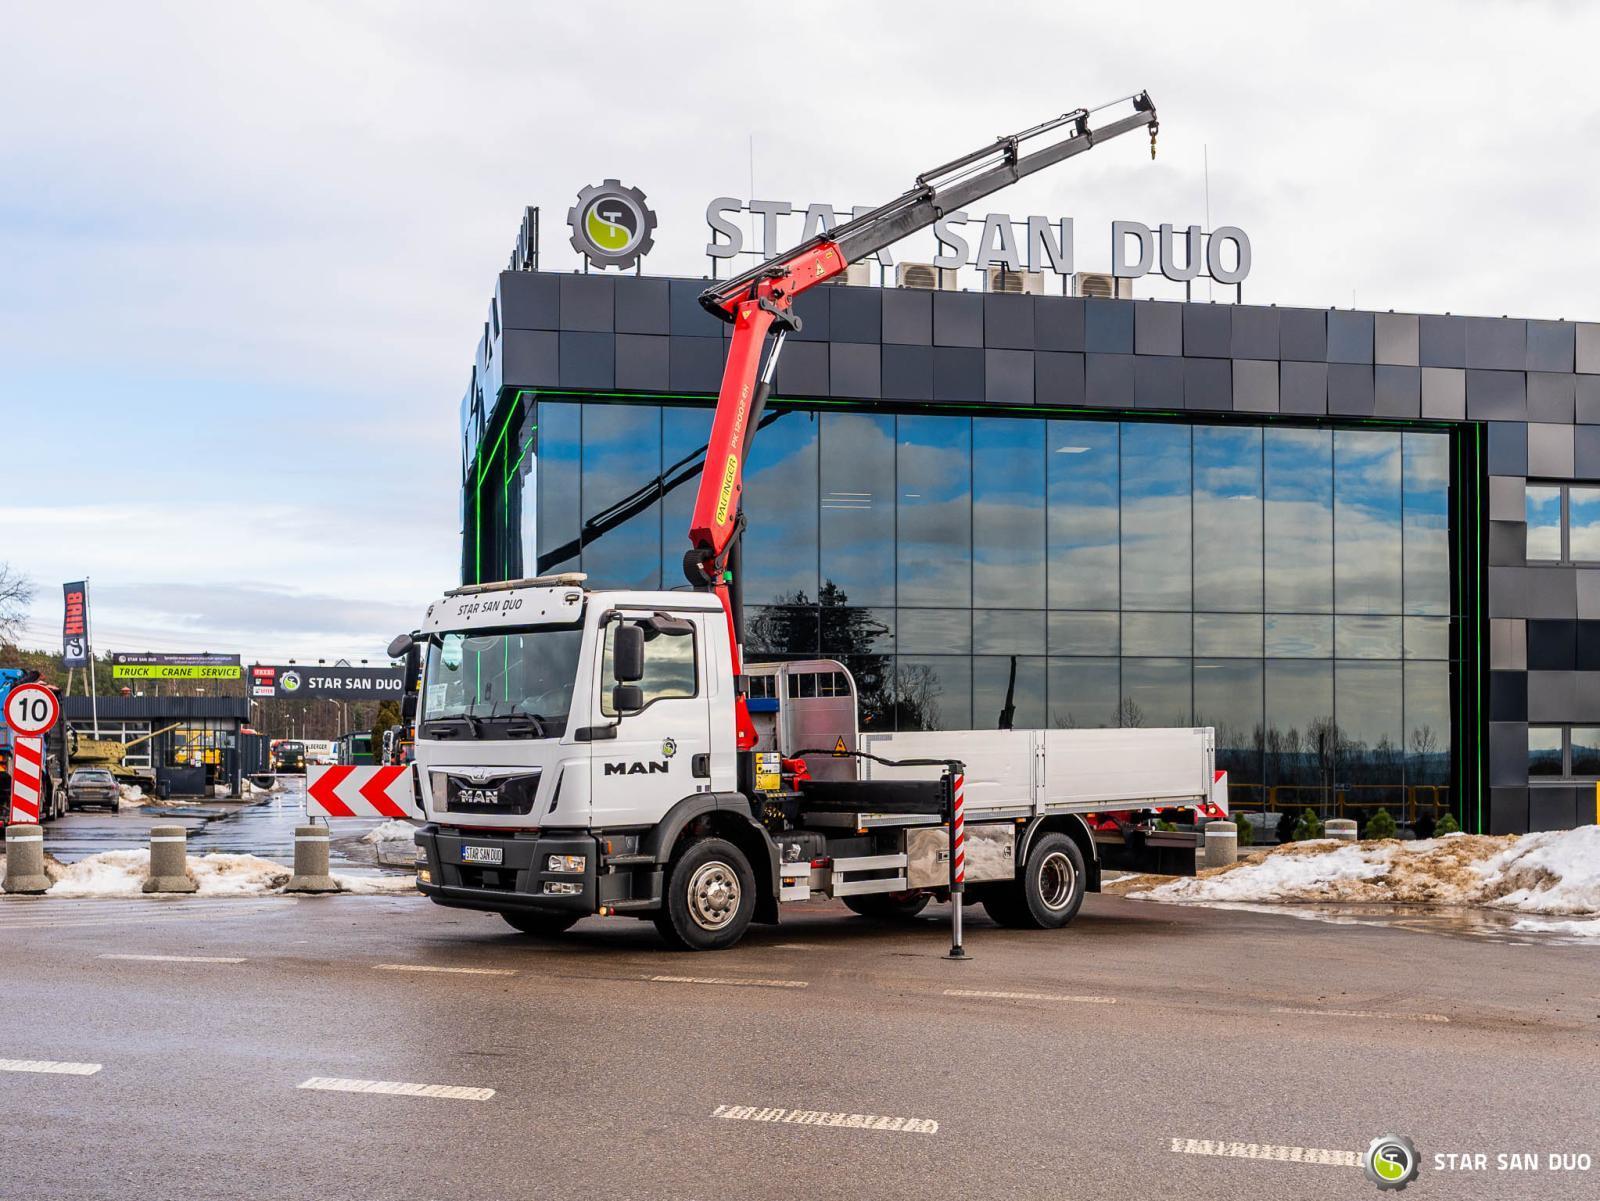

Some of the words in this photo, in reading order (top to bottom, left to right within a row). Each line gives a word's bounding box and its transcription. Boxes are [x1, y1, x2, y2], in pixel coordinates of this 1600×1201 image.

[934, 211, 1074, 275] SAN
[1112, 220, 1252, 285] DUO
[717, 457, 738, 523] PALFINGER
[66, 592, 84, 635] HIAB
[457, 603, 480, 616] STAR
[481, 601, 501, 613] SAN
[502, 598, 523, 611] DUO
[120, 667, 150, 676] TRUCK
[161, 667, 193, 676] CRANE
[200, 667, 238, 677] SERVICE
[308, 677, 342, 689] STAR
[345, 678, 372, 690] SAN
[375, 679, 402, 690] DUO
[19, 697, 48, 722] 10
[604, 761, 669, 776] MAN
[459, 790, 498, 804] MAN
[466, 847, 479, 861] STAR
[480, 848, 491, 861] SAN
[491, 849, 502, 861] DUO
